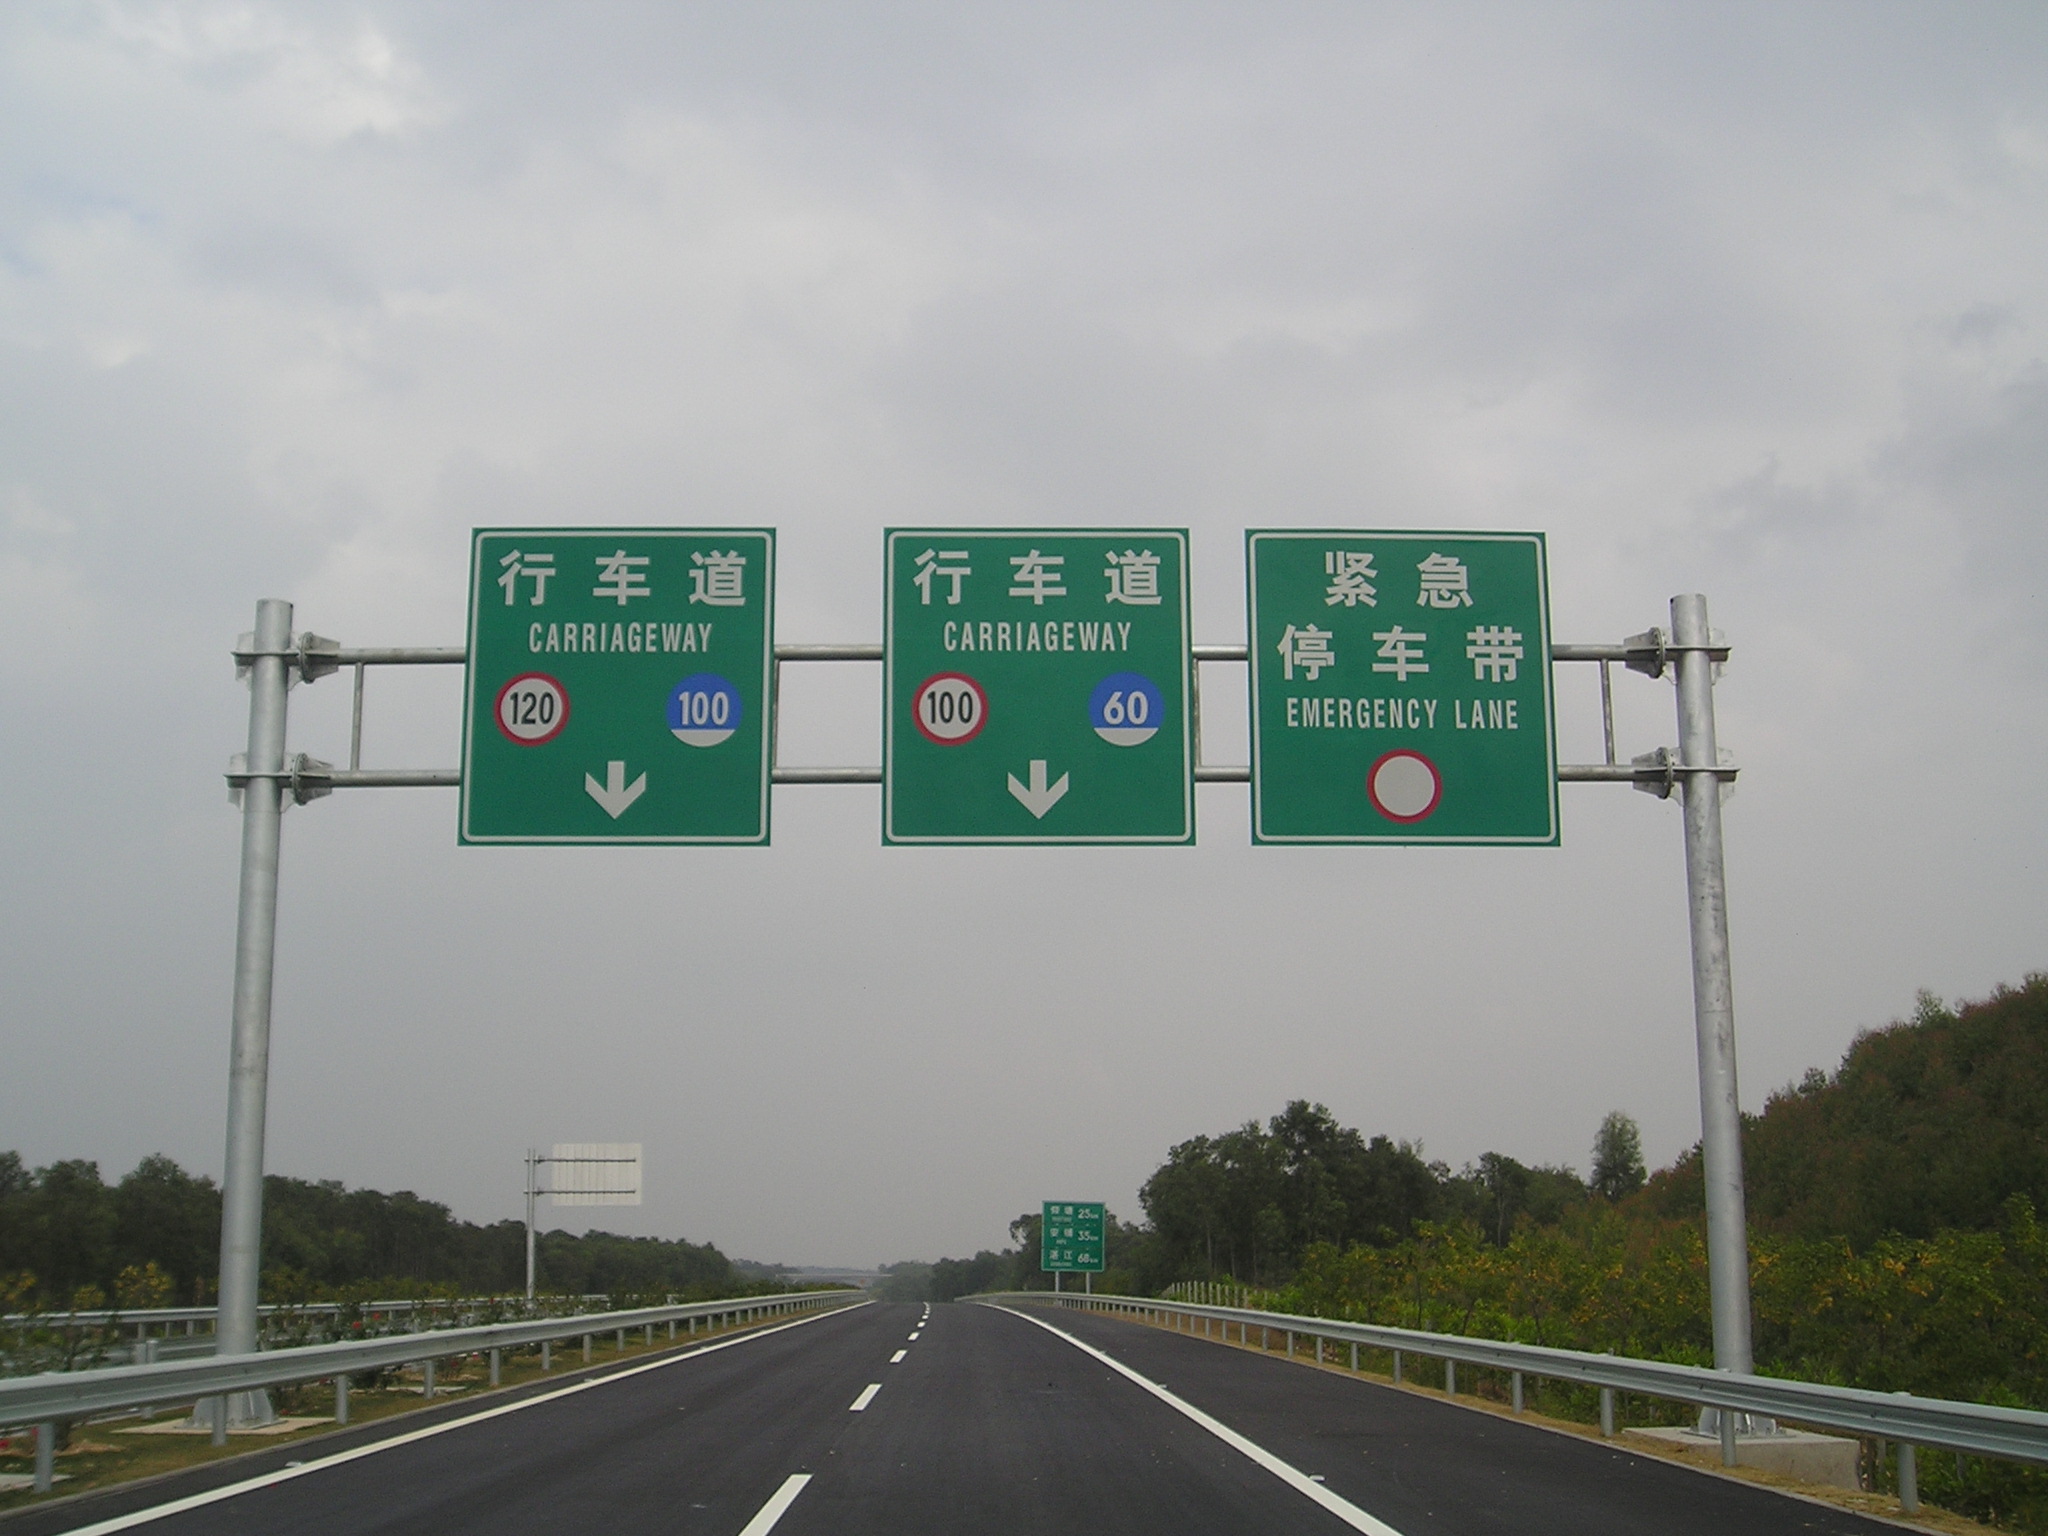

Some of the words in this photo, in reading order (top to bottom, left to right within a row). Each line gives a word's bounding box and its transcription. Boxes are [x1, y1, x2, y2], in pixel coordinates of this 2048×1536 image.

[498, 550, 746, 606] 行车道
[913, 548, 1162, 605] 行车道
[1325, 551, 1473, 608] 紧急
[529, 622, 713, 653] CARRIAGEWAY
[943, 621, 1131, 651] CARRIAGEWAY
[1277, 624, 1523, 682] 停车带
[510, 691, 554, 725] 120
[678, 691, 729, 725] 100
[927, 691, 973, 724] 100
[1103, 691, 1149, 725] 60
[1287, 697, 1437, 729] EMERGENCY
[1455, 699, 1518, 729] LANE
